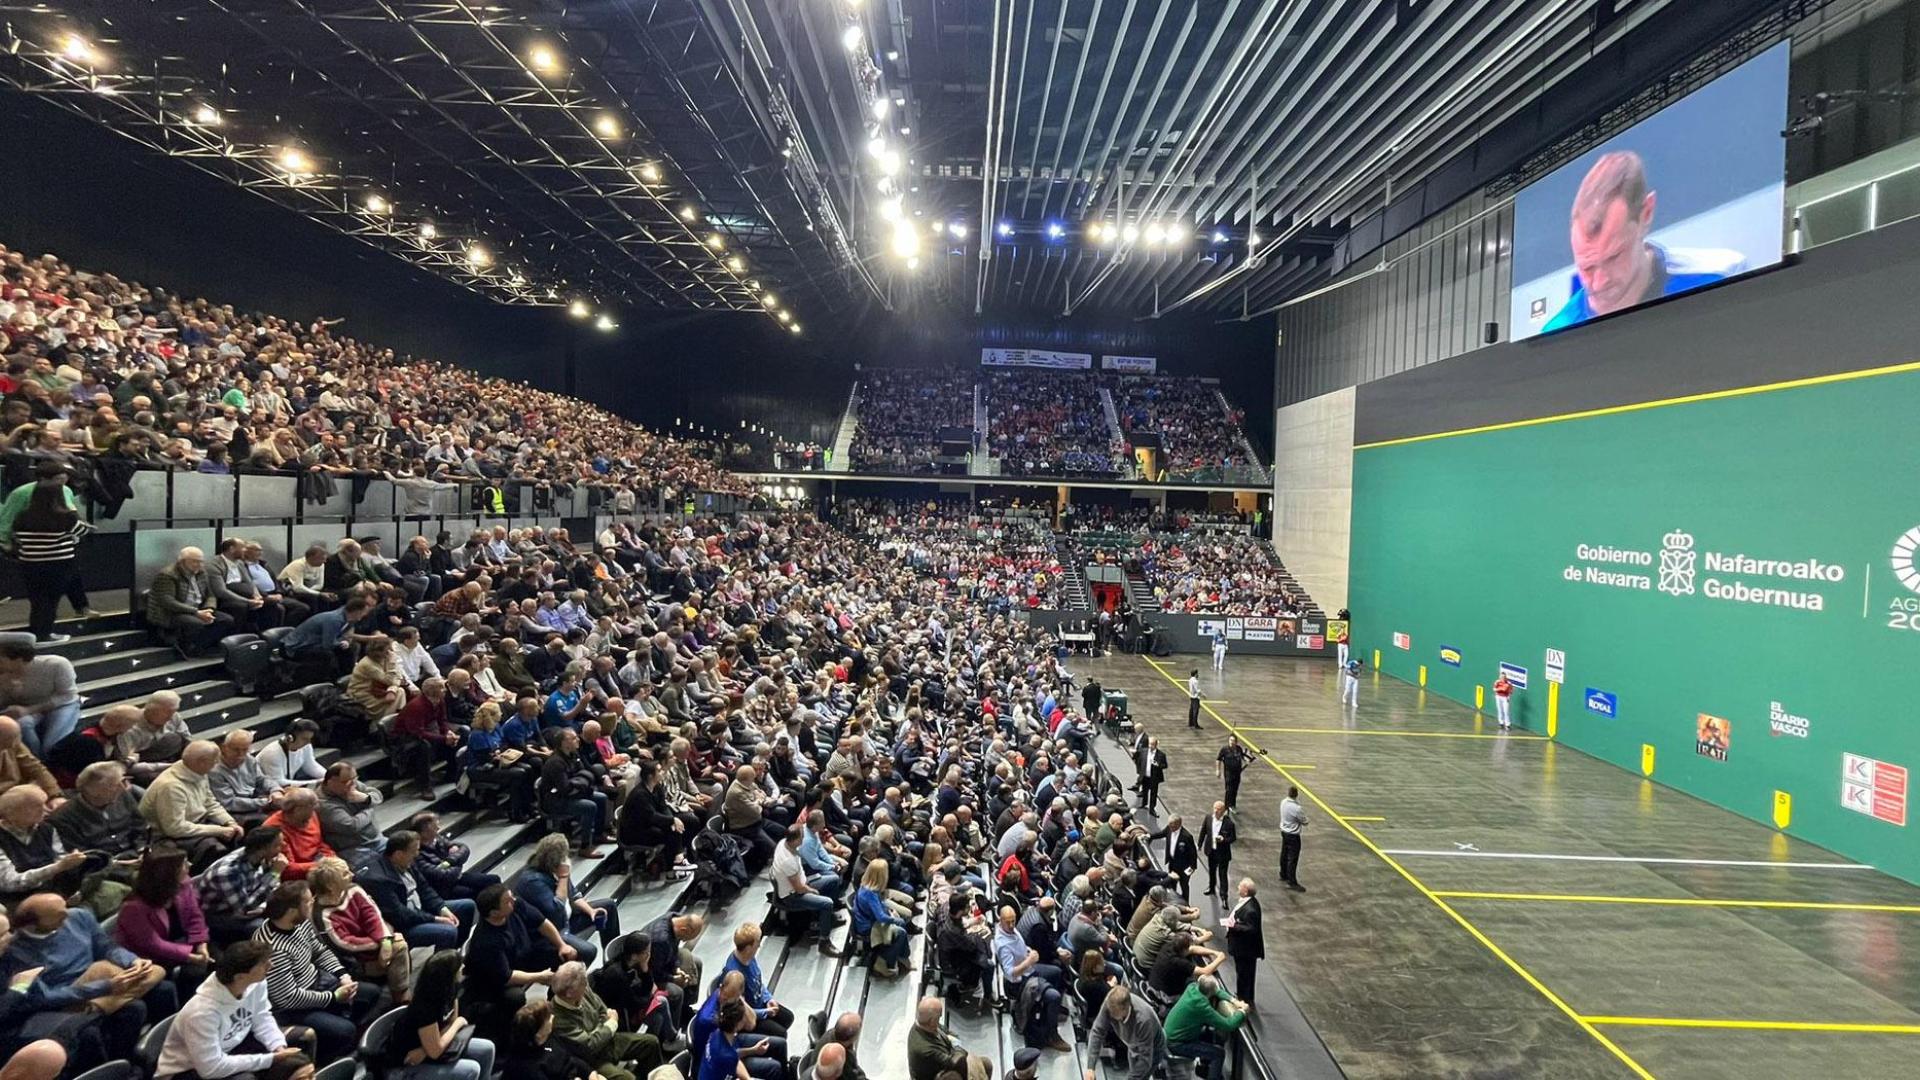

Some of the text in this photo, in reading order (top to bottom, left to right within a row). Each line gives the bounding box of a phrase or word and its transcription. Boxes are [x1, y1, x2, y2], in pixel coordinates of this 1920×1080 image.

[1577, 544, 1652, 565] Gobierno
[1705, 552, 1844, 582] Nafarroako
[1564, 565, 1650, 590] de Navarra
[1703, 578, 1823, 611] Gobernua
[1248, 618, 1273, 627] GARA
[1548, 649, 1562, 664] DN
[1588, 698, 1613, 714] ROYAL
[1770, 701, 1784, 713] EL
[1770, 711, 1809, 728] DIARIO
[1770, 721, 1808, 738] VASCO
[1697, 743, 1727, 761] IRATI
[1778, 794, 1787, 805] 5
